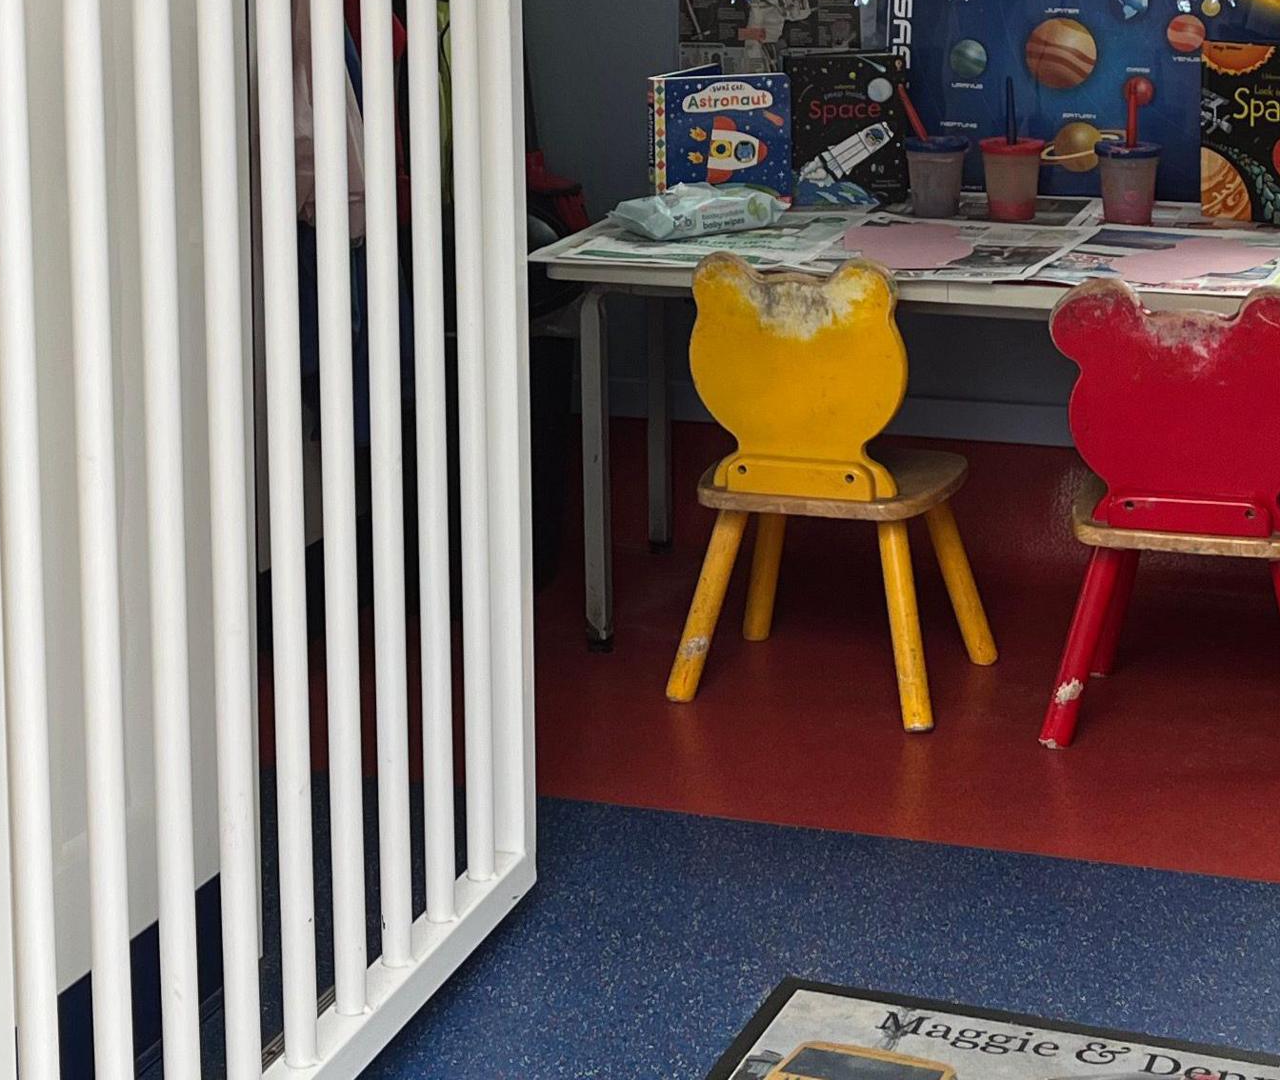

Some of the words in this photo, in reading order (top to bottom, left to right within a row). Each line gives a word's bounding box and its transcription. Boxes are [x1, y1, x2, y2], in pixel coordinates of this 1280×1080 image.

[1045, 7, 1080, 15] JUPITER
[951, 82, 984, 90] URANUS
[1254, 83, 1274, 96] Look
[687, 91, 767, 110] Astronaut
[808, 100, 881, 125] Space
[1062, 112, 1096, 120] SATURN
[940, 121, 978, 129] NEPTUNE
[702, 220, 723, 230] baby
[724, 217, 745, 227] wipes
[875, 1010, 1060, 1057] Maggie
[1074, 1041, 1132, 1066] &
